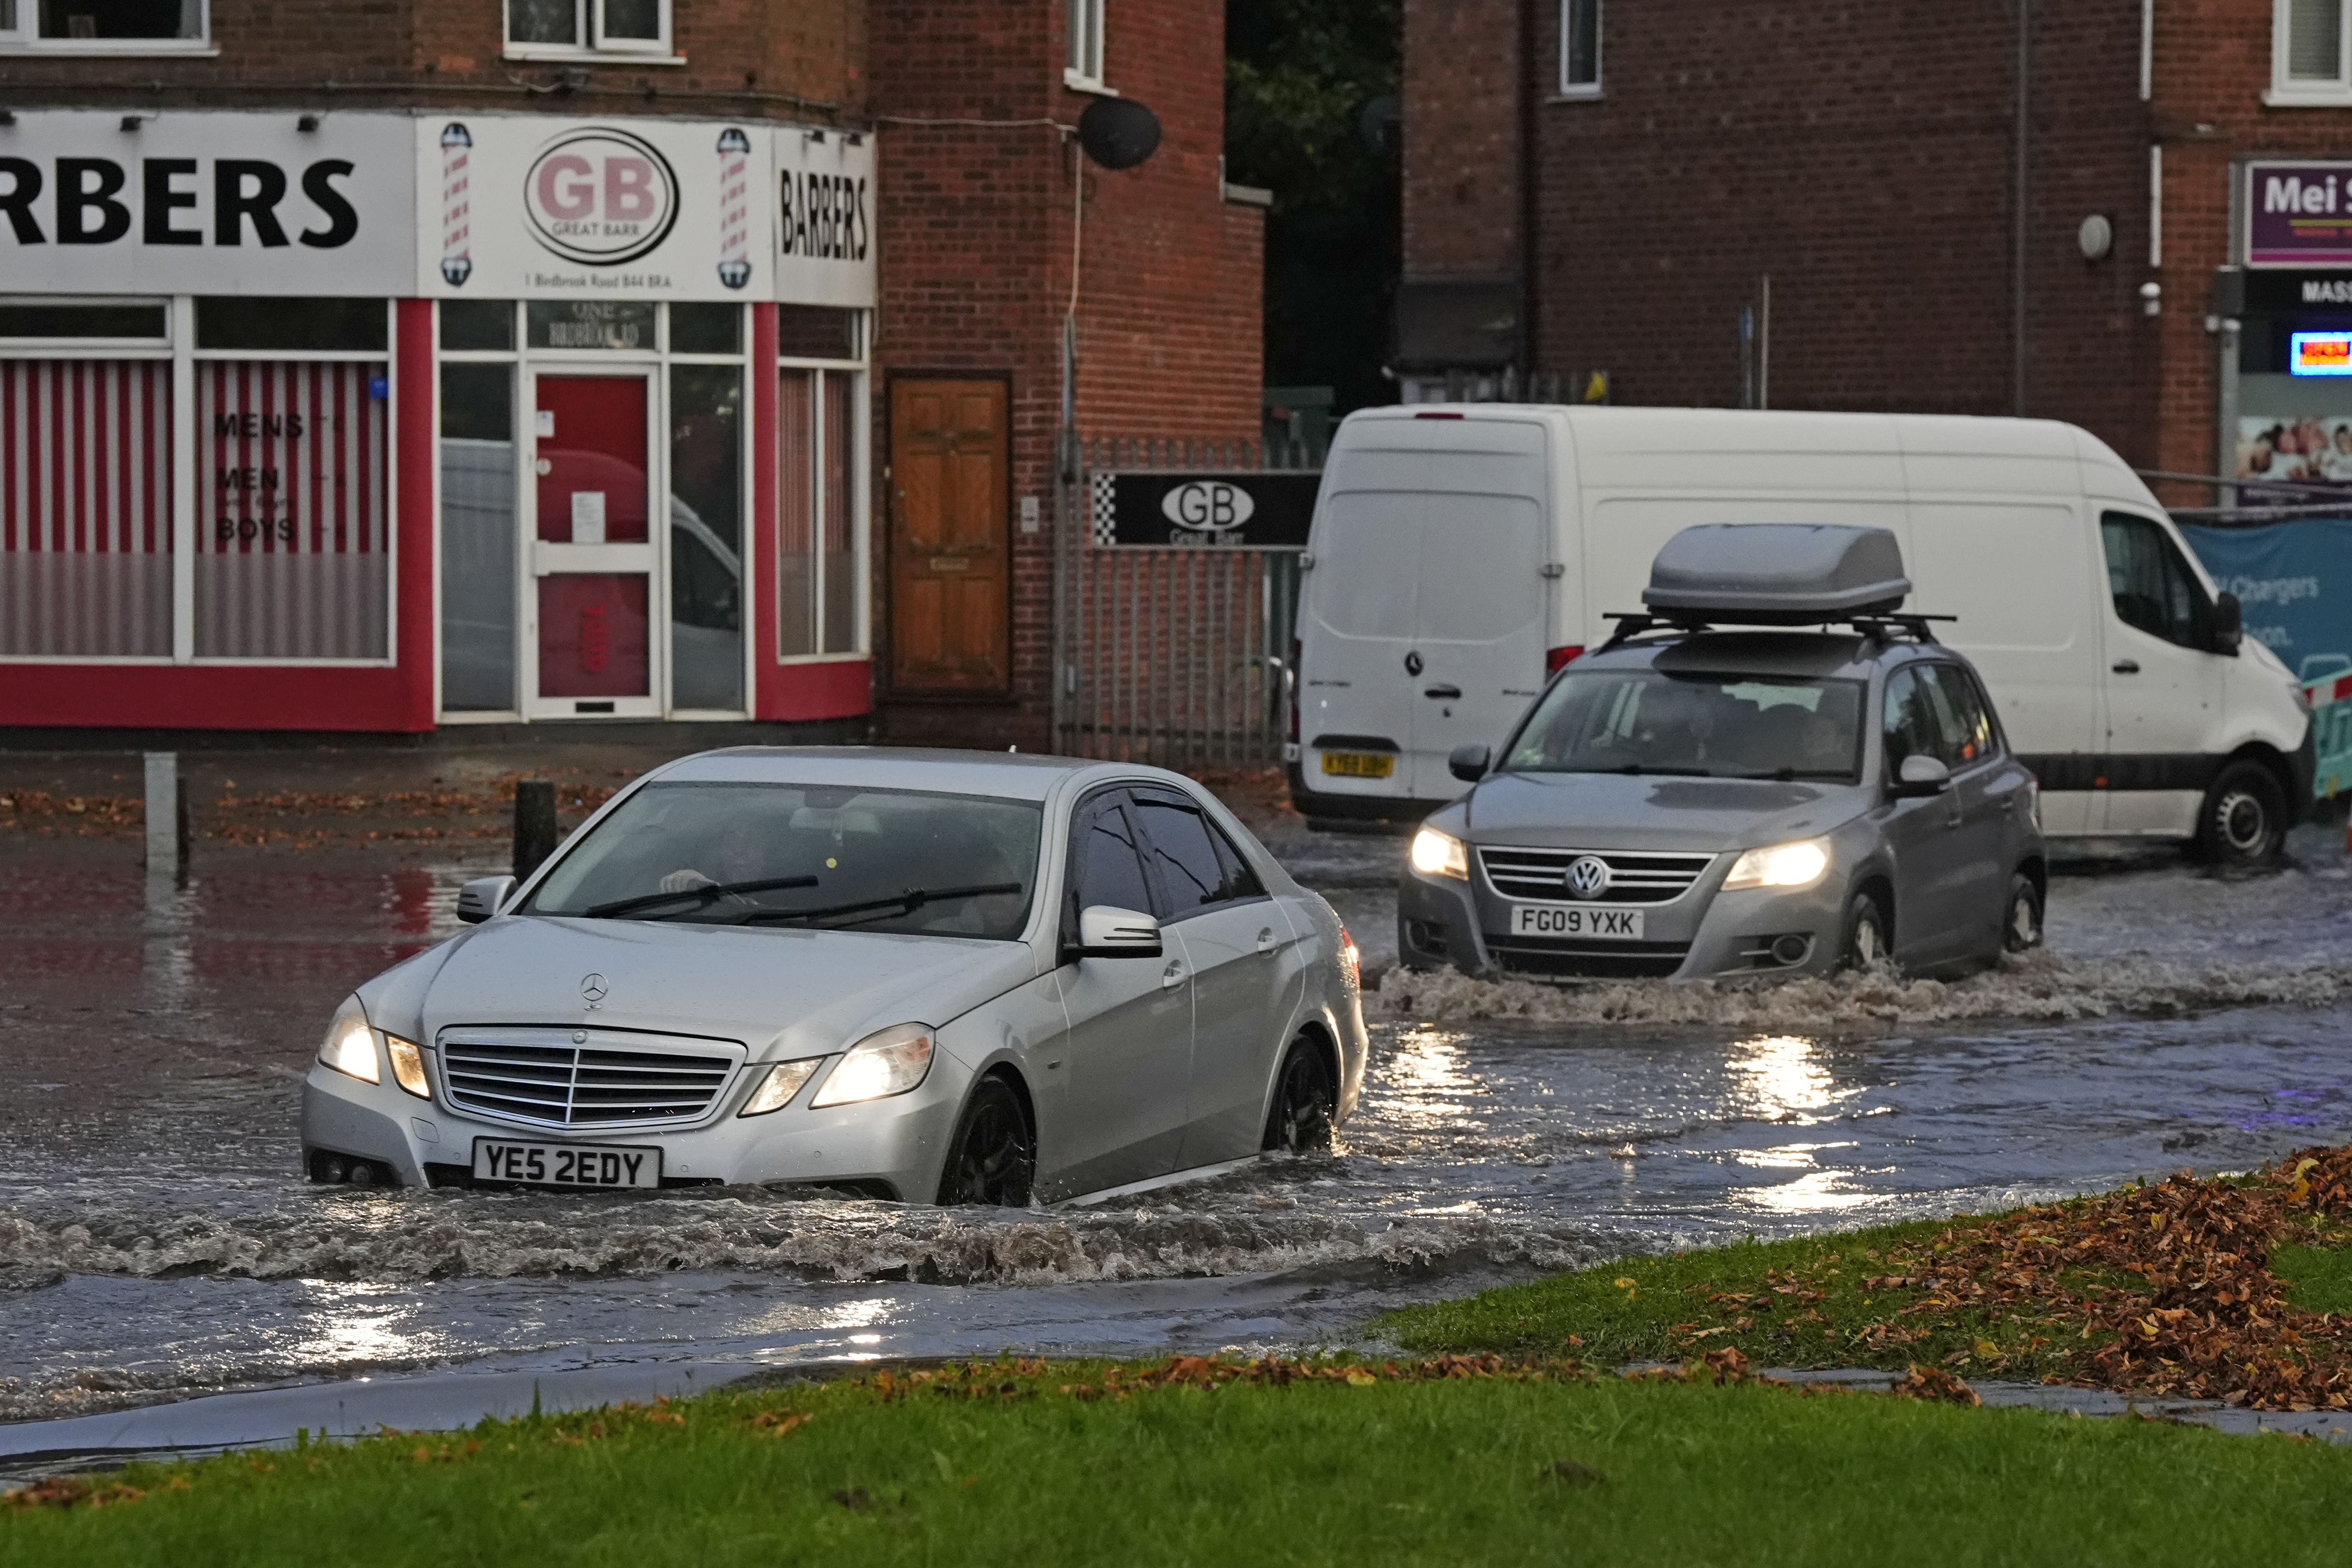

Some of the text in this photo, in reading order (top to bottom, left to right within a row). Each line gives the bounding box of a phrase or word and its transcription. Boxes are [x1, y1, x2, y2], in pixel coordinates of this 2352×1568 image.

[537, 154, 655, 220] GB
[2264, 175, 2338, 213] Mei
[781, 169, 867, 261] BARBERS
[552, 221, 640, 236] GREAT BARR
[591, 273, 619, 288] Road
[214, 413, 303, 438] MENS
[217, 467, 278, 491] MEN
[1179, 485, 1235, 526] GB
[216, 516, 294, 542] BOYS
[1522, 909, 1634, 934] FG09 YXK
[487, 1144, 643, 1185] YE5 2EDY
